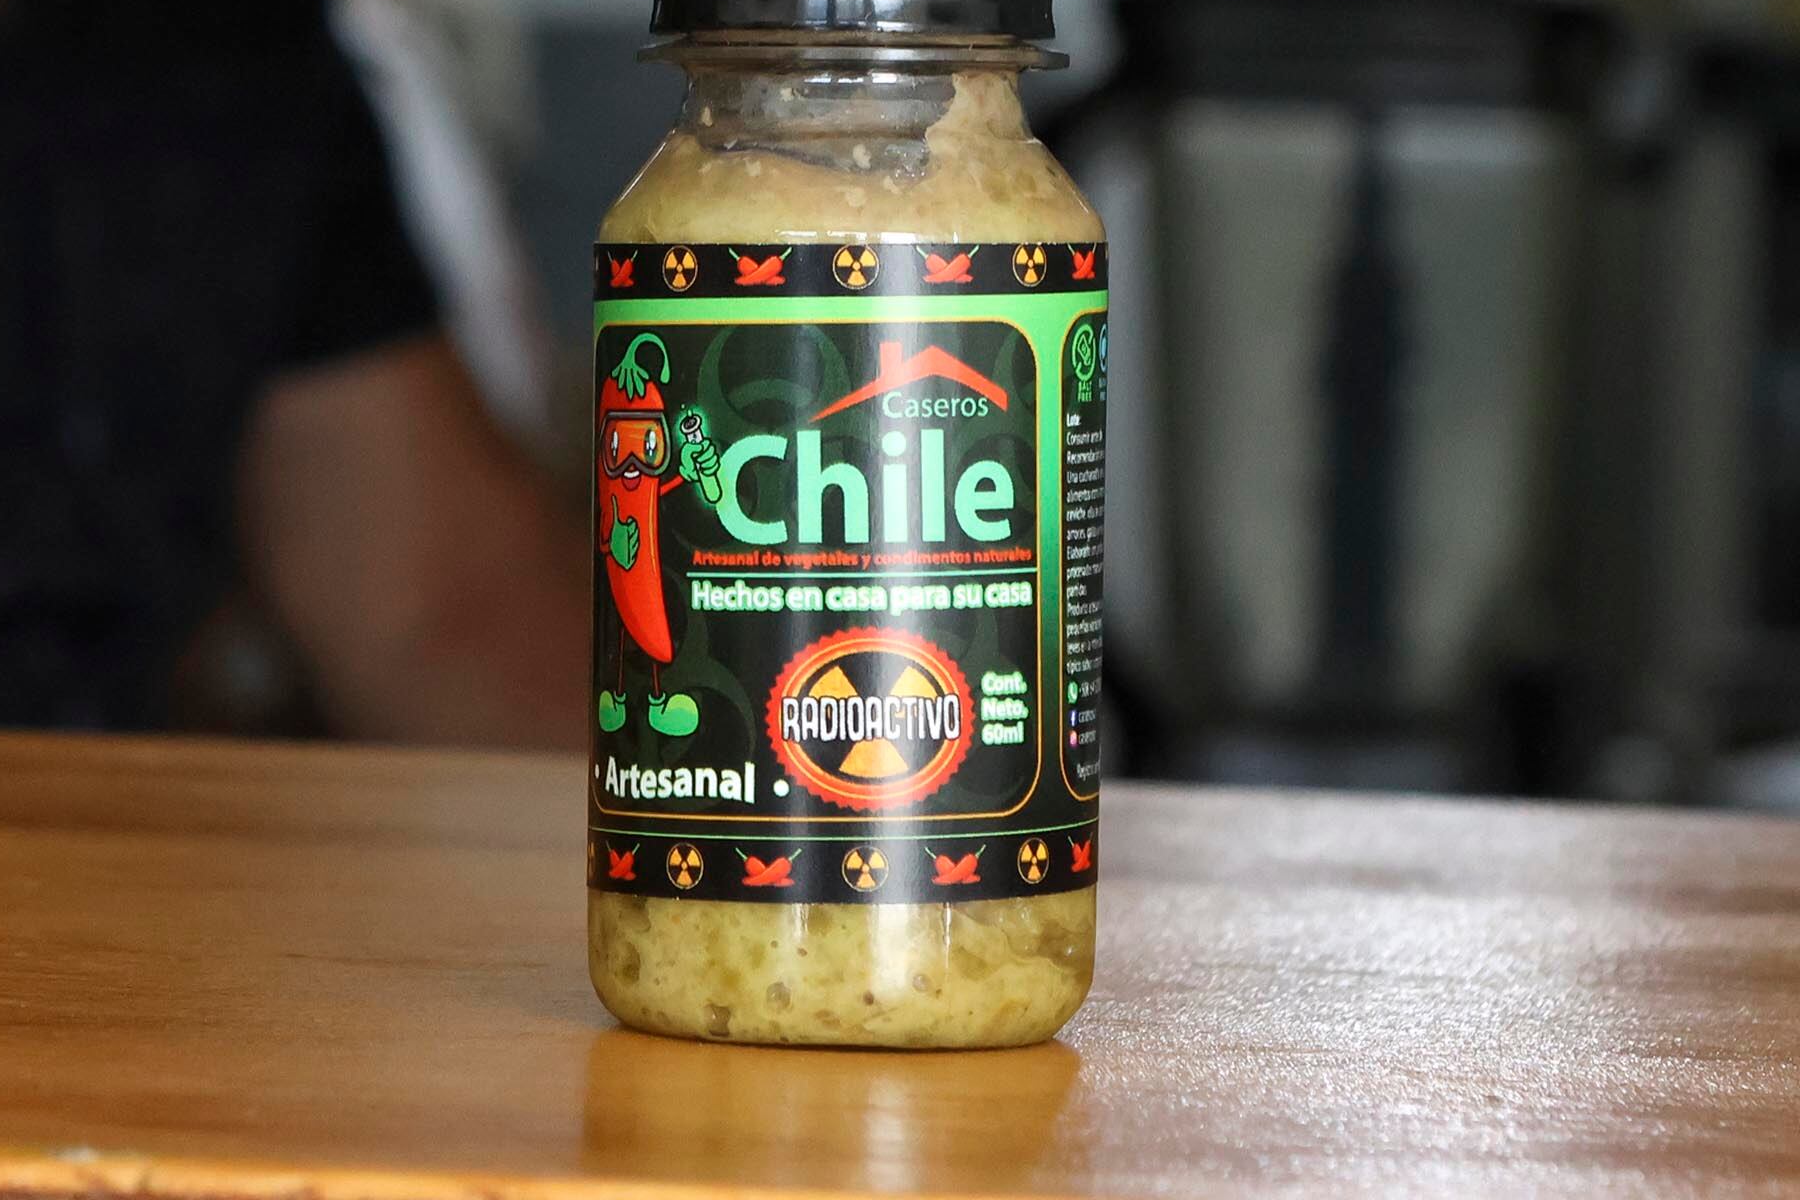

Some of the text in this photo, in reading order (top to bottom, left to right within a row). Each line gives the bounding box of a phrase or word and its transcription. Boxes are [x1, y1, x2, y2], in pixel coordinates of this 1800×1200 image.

[882, 391, 989, 418] Caseros
[716, 429, 1014, 545] Chile
[693, 546, 1032, 570] Artesanal de vegetales y condimentos naturales
[692, 580, 1032, 616] Hechos en casa para su casa
[981, 671, 1027, 696] Cont.
[782, 694, 961, 742] RADIOACTIVO
[981, 697, 1029, 721] Neto.
[982, 721, 1024, 745] 60ml
[605, 756, 756, 804] Artesanal
